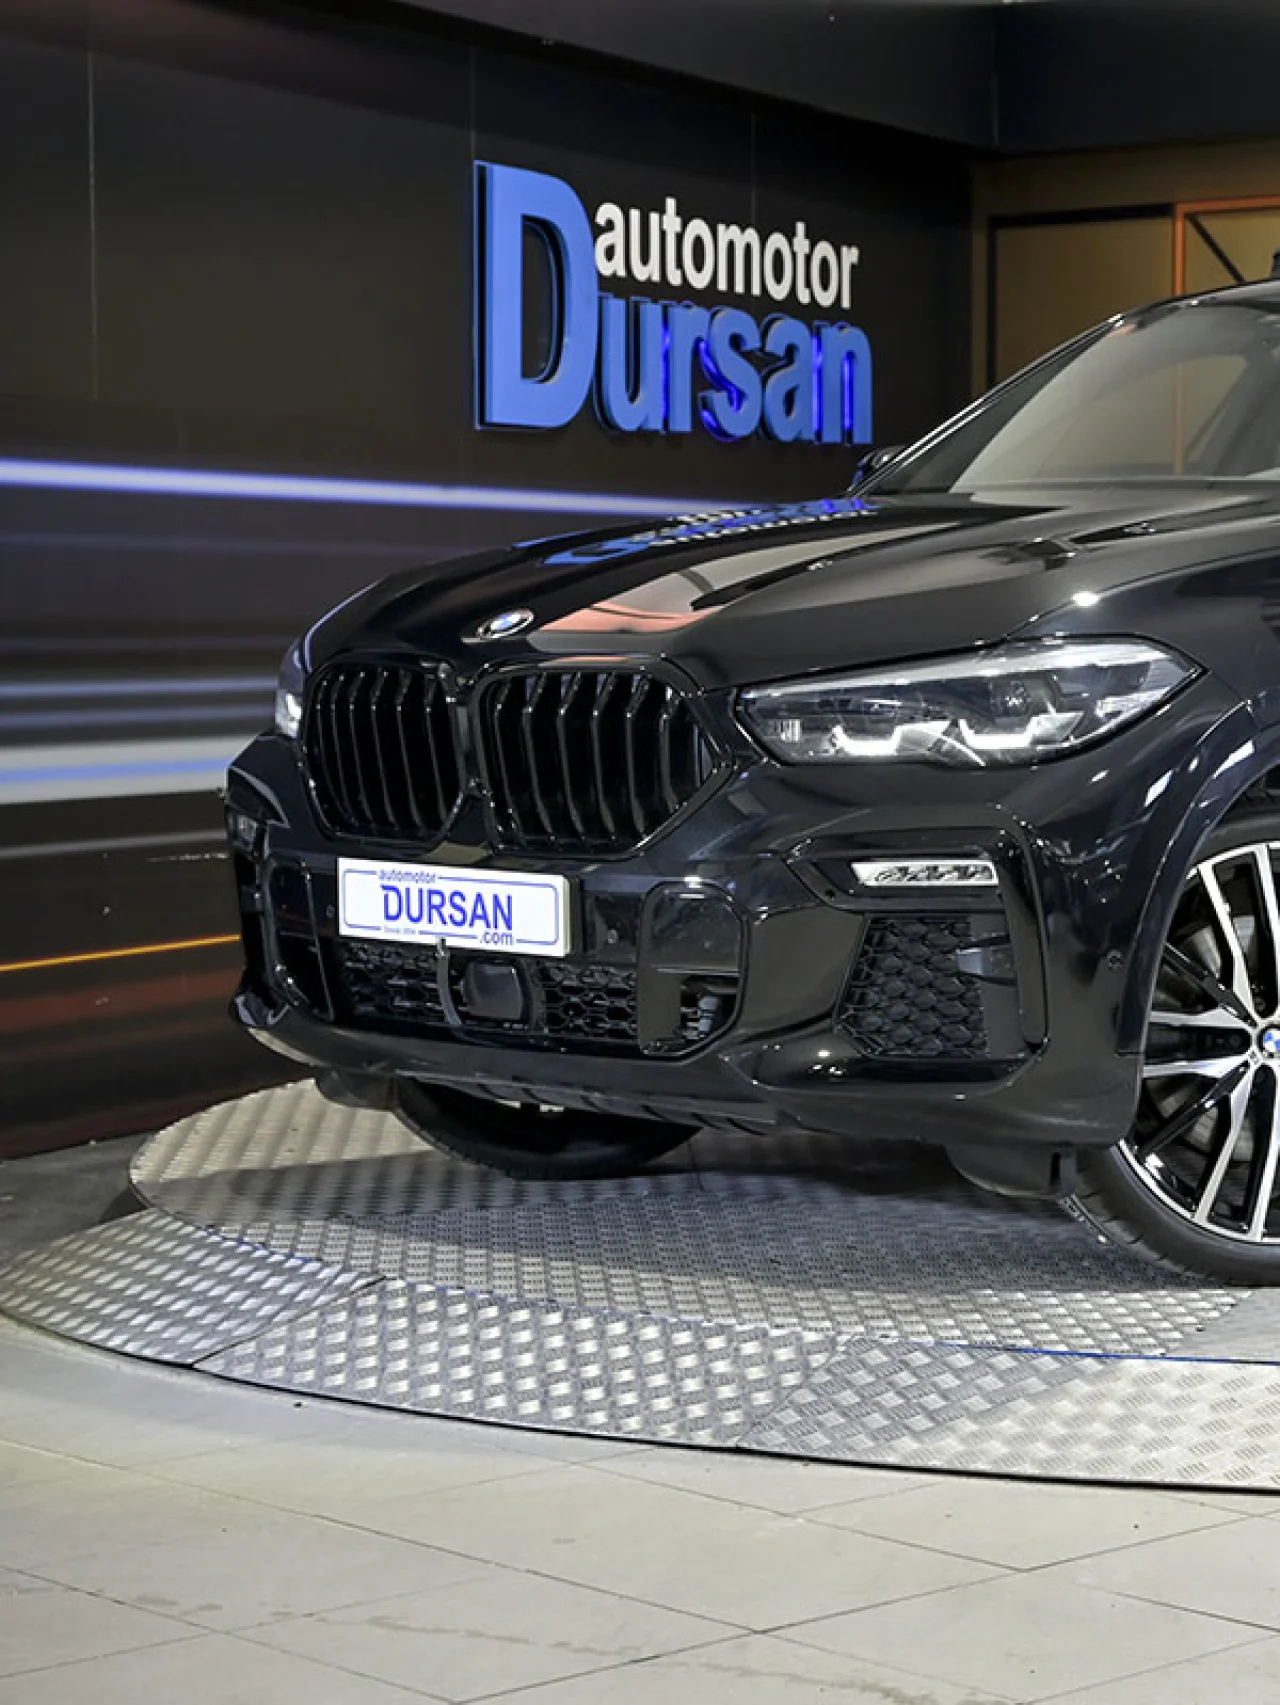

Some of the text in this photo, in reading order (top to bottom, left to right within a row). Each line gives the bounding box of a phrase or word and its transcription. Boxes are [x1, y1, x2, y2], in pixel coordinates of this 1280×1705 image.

[595, 197, 859, 309] automotor
[475, 160, 874, 445] Dursan
[379, 869, 436, 884] automotor
[380, 885, 513, 931] DURSAN
[480, 932, 514, 946] .com
